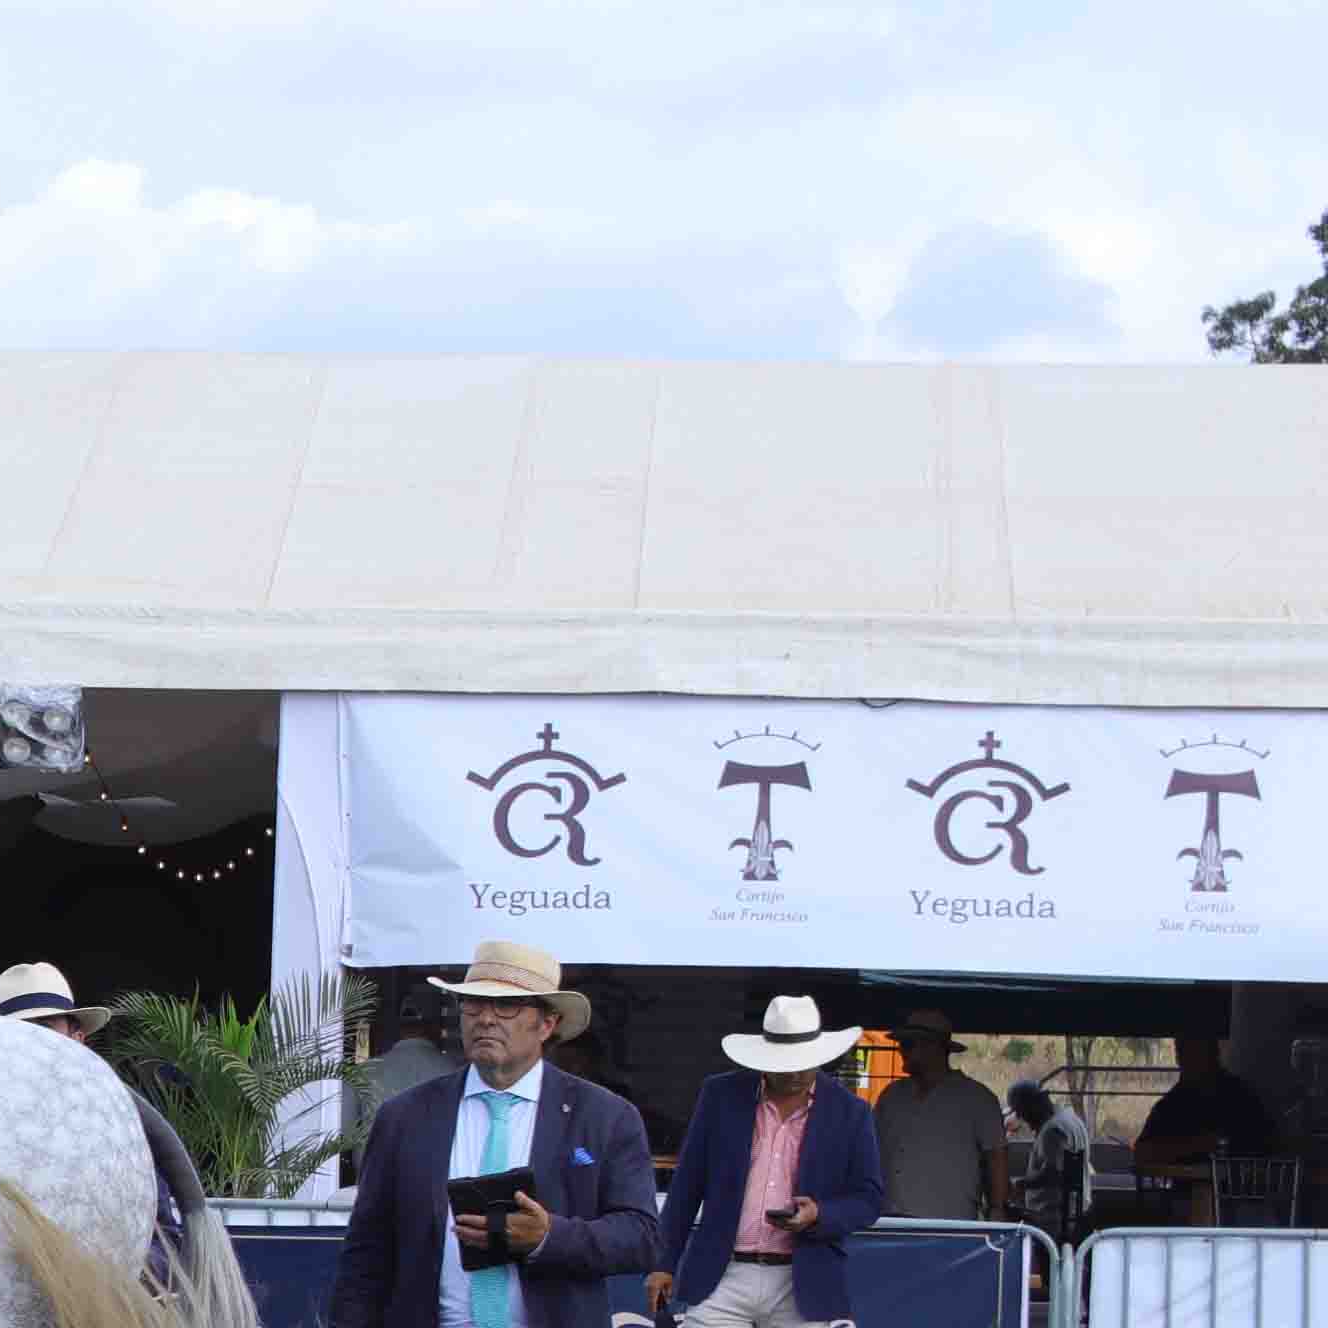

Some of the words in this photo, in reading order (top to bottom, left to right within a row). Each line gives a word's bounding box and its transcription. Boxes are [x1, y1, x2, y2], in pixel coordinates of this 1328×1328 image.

[469, 884, 612, 916] Yeguada
[708, 907, 735, 922] San
[739, 908, 809, 923] Francisco
[910, 890, 1057, 924] Yeguada
